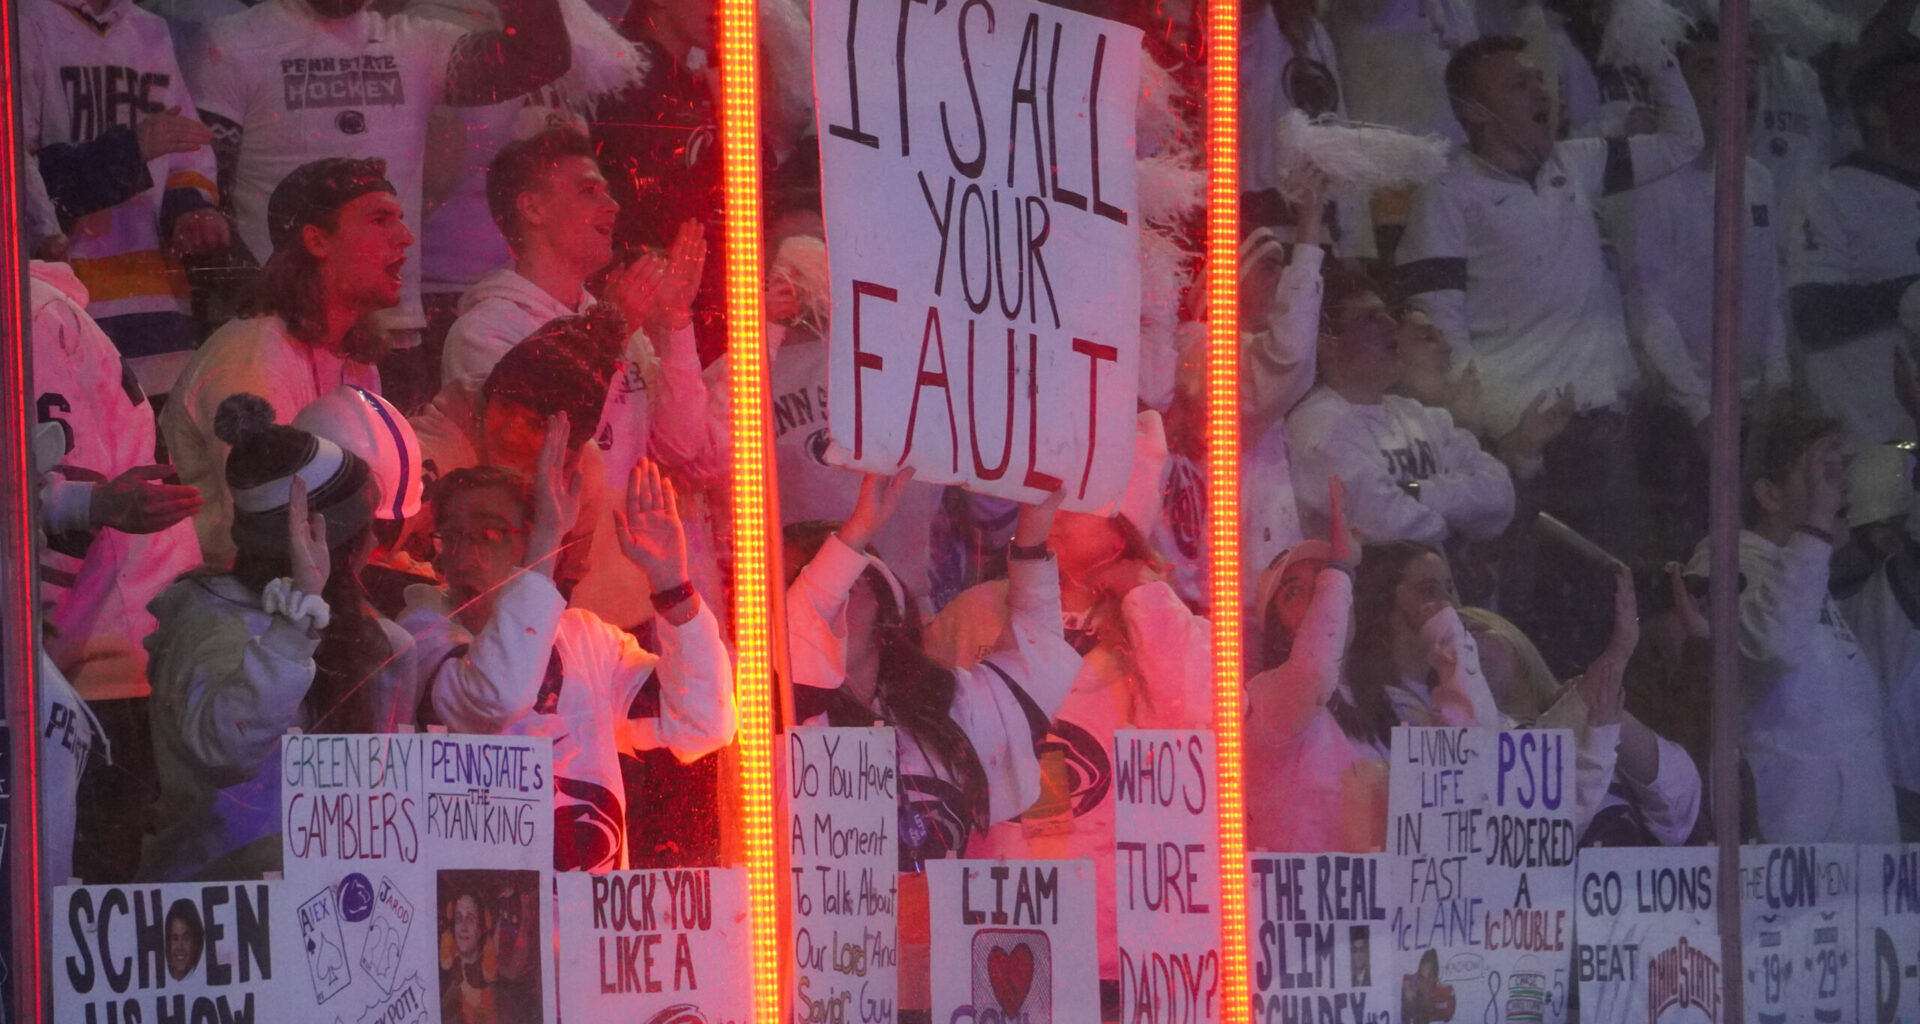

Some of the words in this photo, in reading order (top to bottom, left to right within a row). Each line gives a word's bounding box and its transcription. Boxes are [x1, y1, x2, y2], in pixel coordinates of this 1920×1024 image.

[280, 57, 335, 74] PENN
[339, 54, 398, 71] STATE
[288, 78, 397, 101] HOCKEY
[829, 0, 996, 179] IT'S
[1007, 13, 1128, 226] ALL
[917, 170, 1061, 330] YOUR
[851, 279, 1118, 501] FAULT
[285, 735, 362, 788] GREEN
[369, 736, 413, 792] BAY
[790, 732, 819, 800] Do
[822, 734, 853, 799] You
[858, 739, 894, 801] Have
[1407, 728, 1469, 767] LIVING
[1496, 731, 1562, 811] PSU
[467, 788, 491, 806] THE
[1114, 735, 1207, 816] WHO'S
[1421, 769, 1465, 809] LIFE
[288, 792, 418, 863] GAMBLERS
[427, 793, 478, 842] RYAN
[483, 802, 536, 847] KING
[791, 813, 806, 857] A
[814, 812, 888, 860] Moment
[1396, 812, 1422, 857] IN
[1441, 808, 1483, 854] THE
[592, 874, 656, 932] ROCK
[662, 869, 713, 932] YOU
[791, 866, 813, 916] To
[815, 865, 853, 916] Talk
[857, 866, 898, 917] About
[962, 866, 1059, 927] LIAM
[1116, 841, 1210, 914] TURE
[1251, 858, 1306, 921] THE
[1316, 856, 1386, 922] REAL
[1410, 855, 1468, 904] FAST
[1513, 871, 1532, 909] A
[1582, 870, 1622, 918] GO
[1635, 865, 1712, 914] LIONS
[1766, 845, 1816, 910] CON
[598, 934, 662, 995] LIKE
[674, 933, 697, 992] A
[796, 926, 827, 973] Our
[832, 926, 868, 977] Lord
[871, 926, 898, 968] And
[1257, 920, 1336, 991] SLIM
[1579, 943, 1639, 982] BEAT
[1762, 953, 1781, 1005] 19
[1815, 949, 1838, 1000] 29
[1119, 946, 1219, 1024] DADDY?
